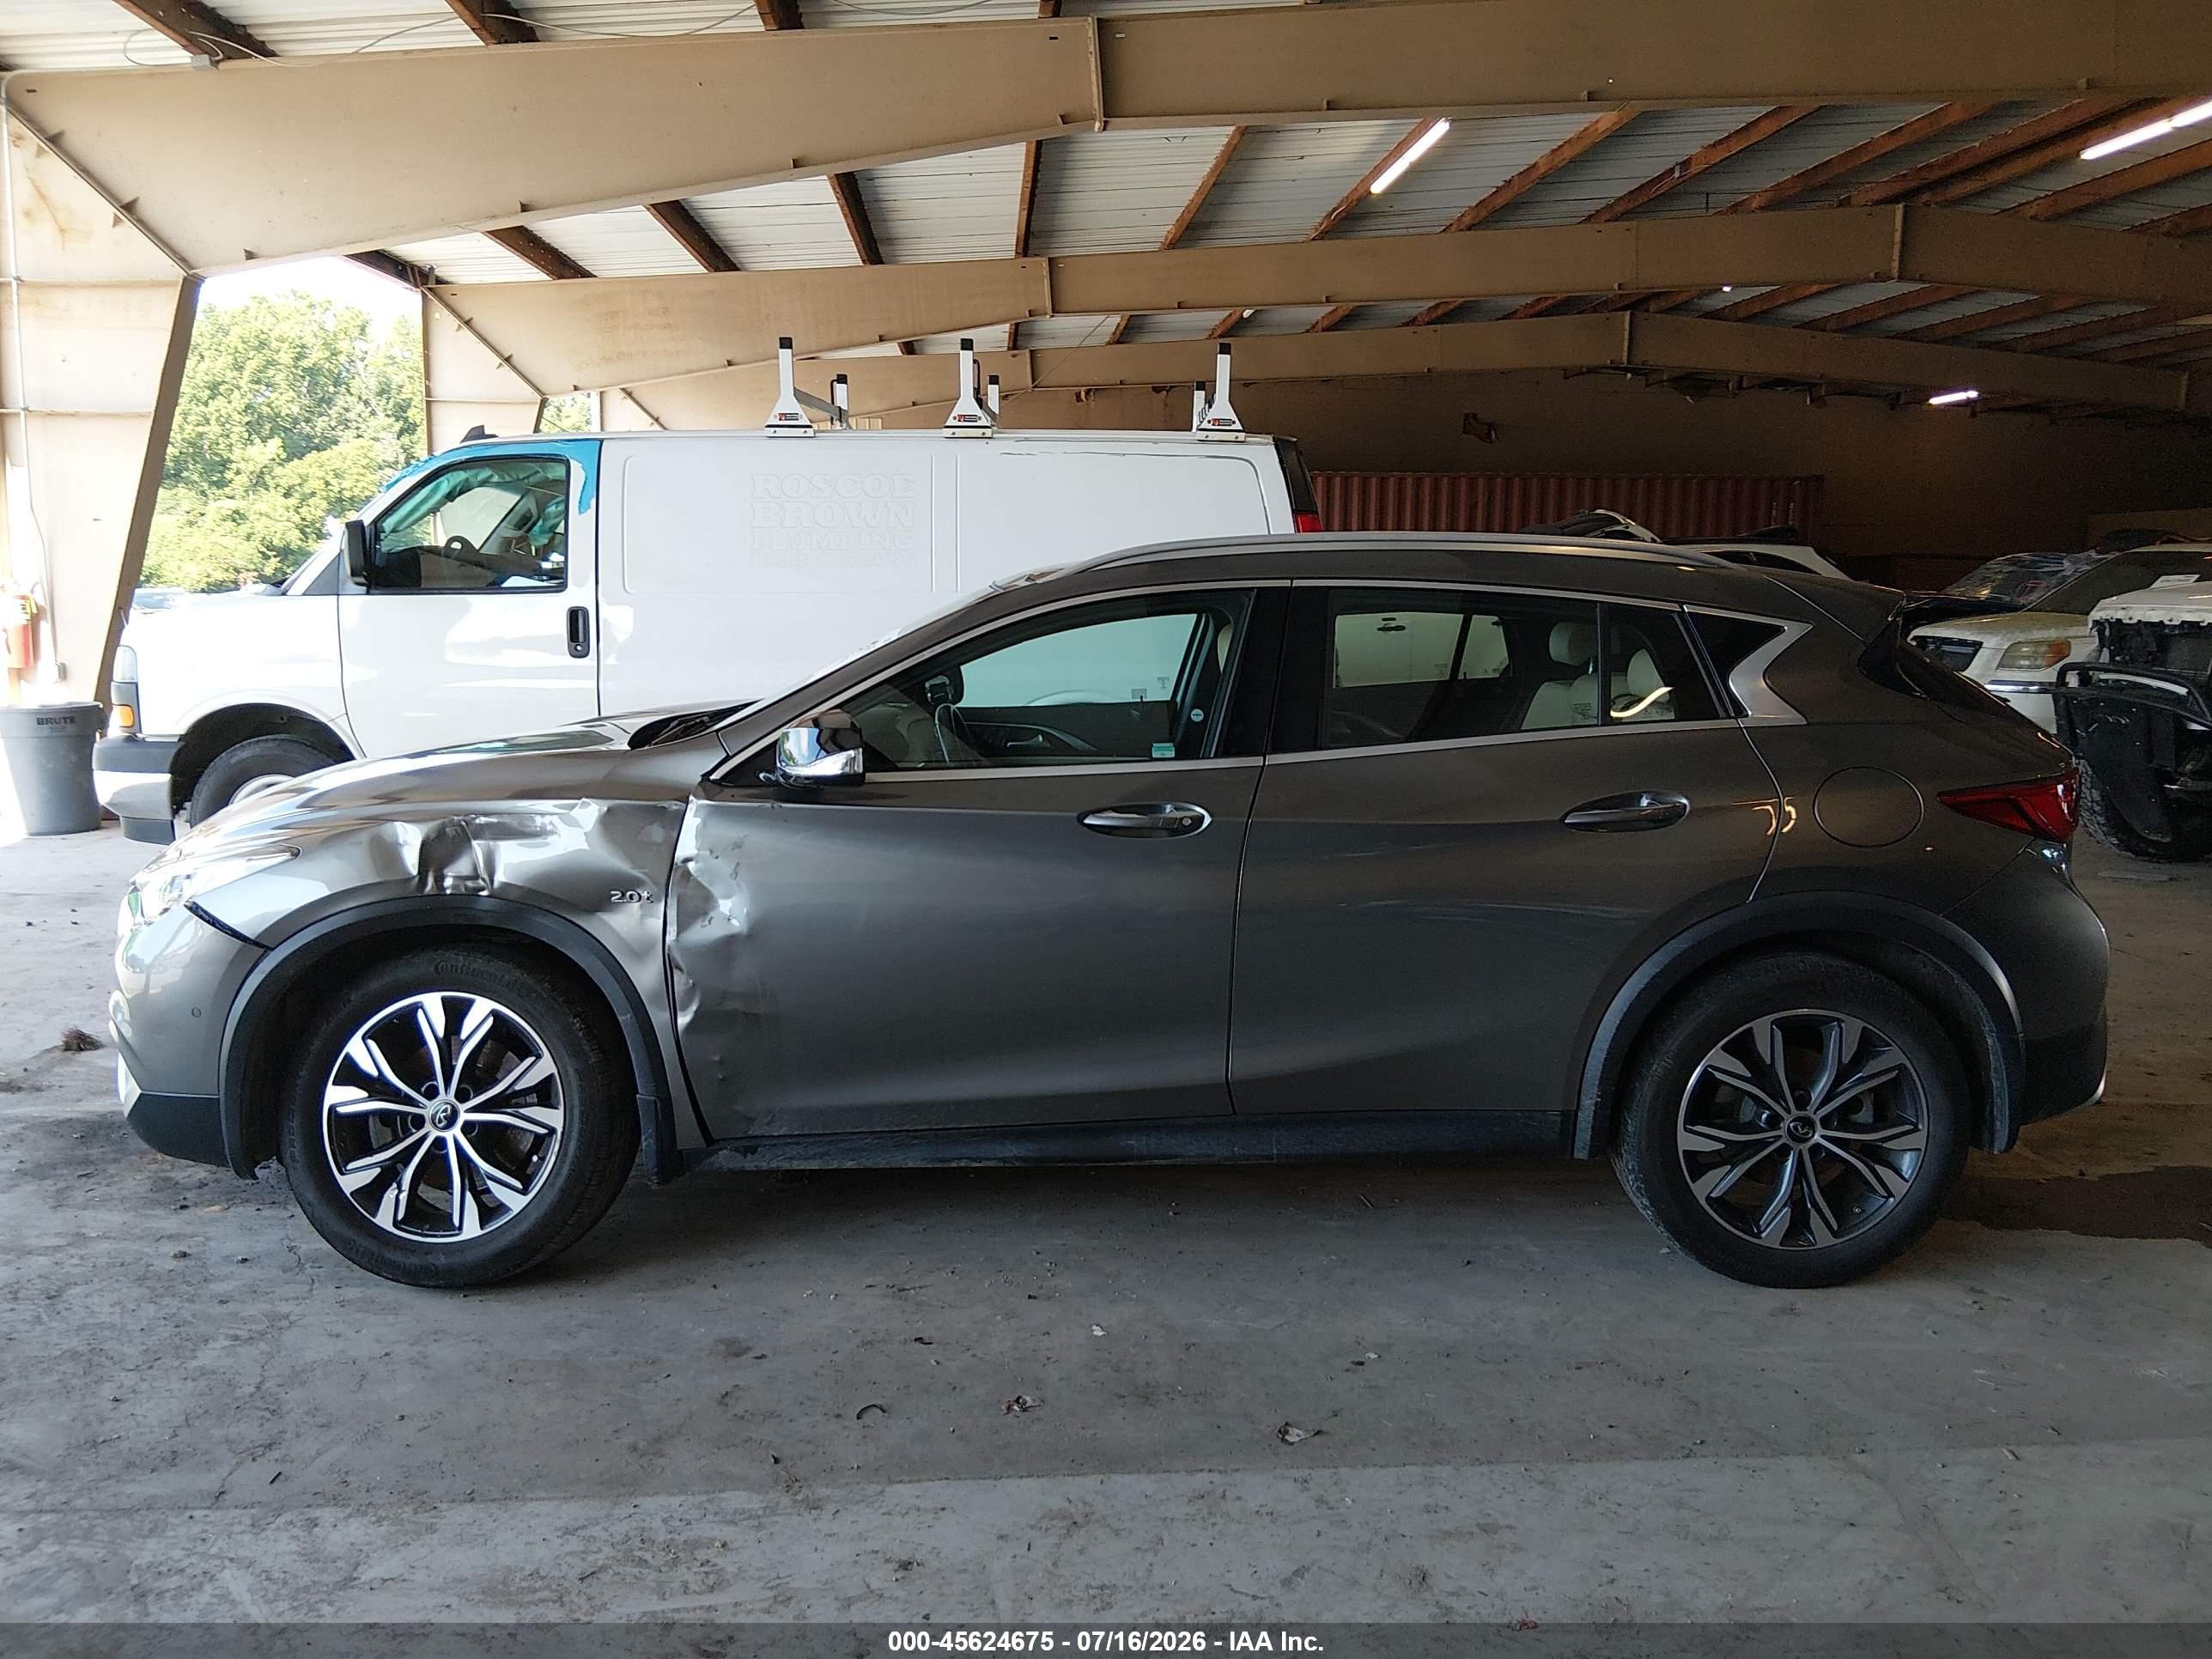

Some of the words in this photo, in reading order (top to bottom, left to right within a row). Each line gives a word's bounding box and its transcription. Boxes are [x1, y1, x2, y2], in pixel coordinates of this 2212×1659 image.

[750, 473, 916, 499] ROSCOE
[750, 501, 917, 529] BROWN
[750, 531, 916, 551] PLUMBING
[36, 716, 76, 726] BRUTE
[610, 890, 653, 903] 2.0t
